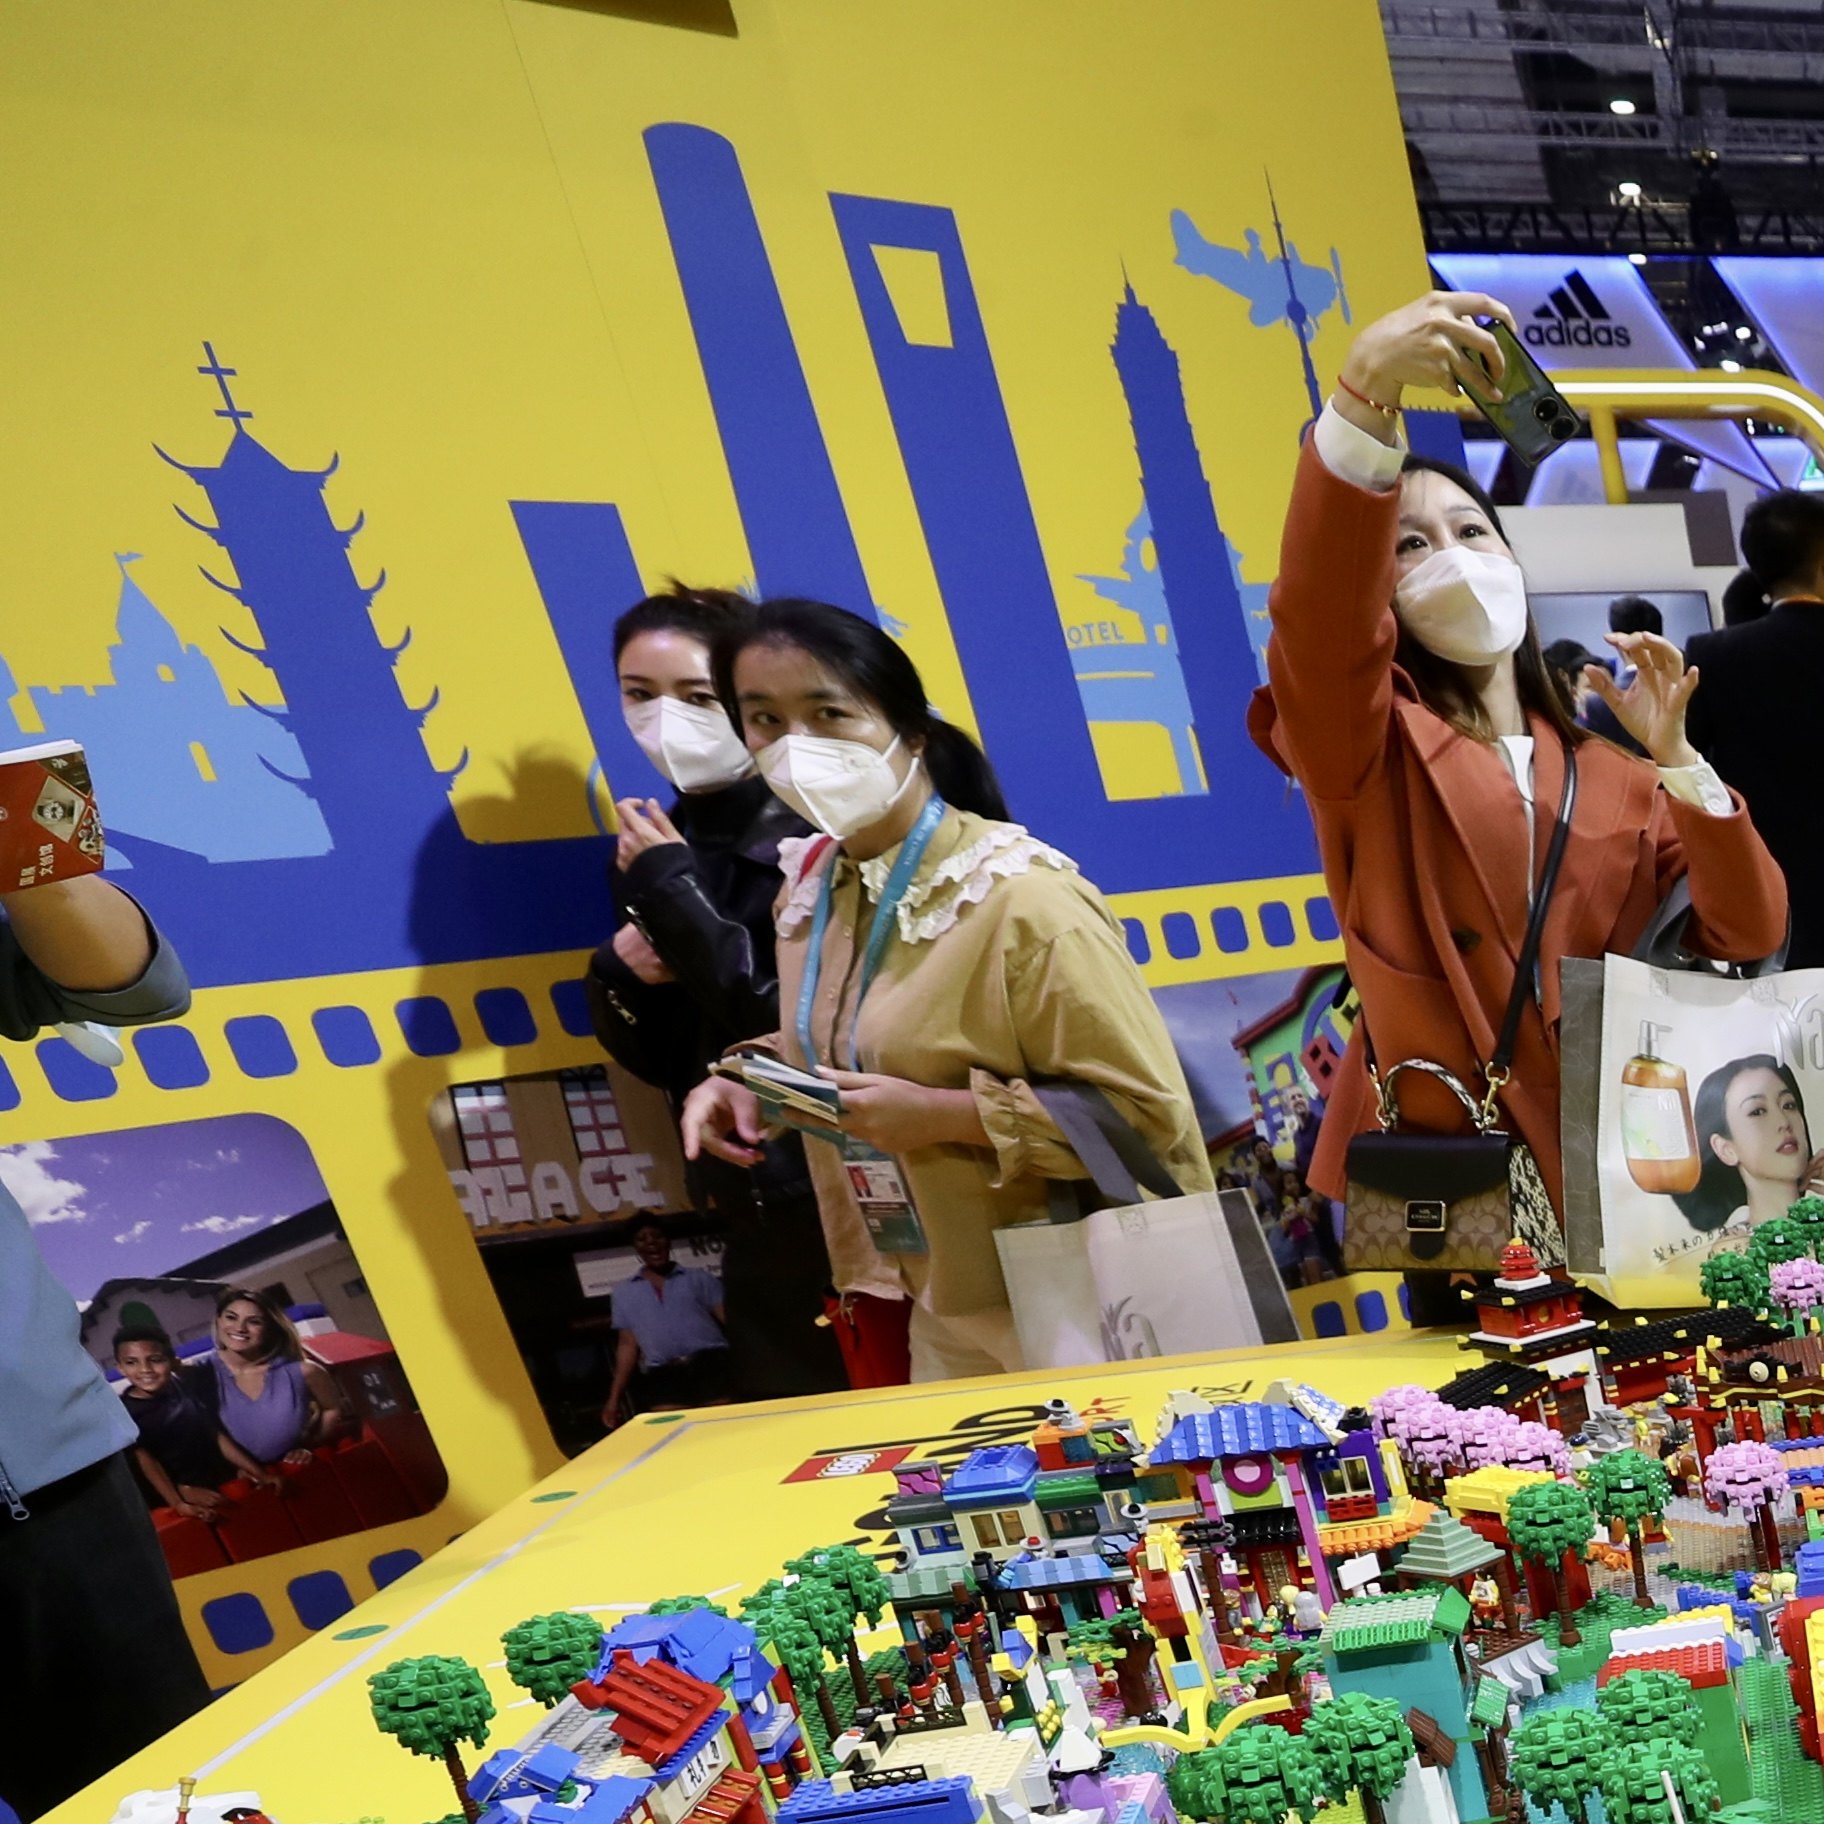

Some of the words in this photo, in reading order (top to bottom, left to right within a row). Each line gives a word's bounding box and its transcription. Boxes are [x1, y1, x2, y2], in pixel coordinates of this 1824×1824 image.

[1524, 319, 1632, 347] adidas
[1067, 621, 1124, 644] OTEL
[816, 1451, 881, 1478] LEGO
